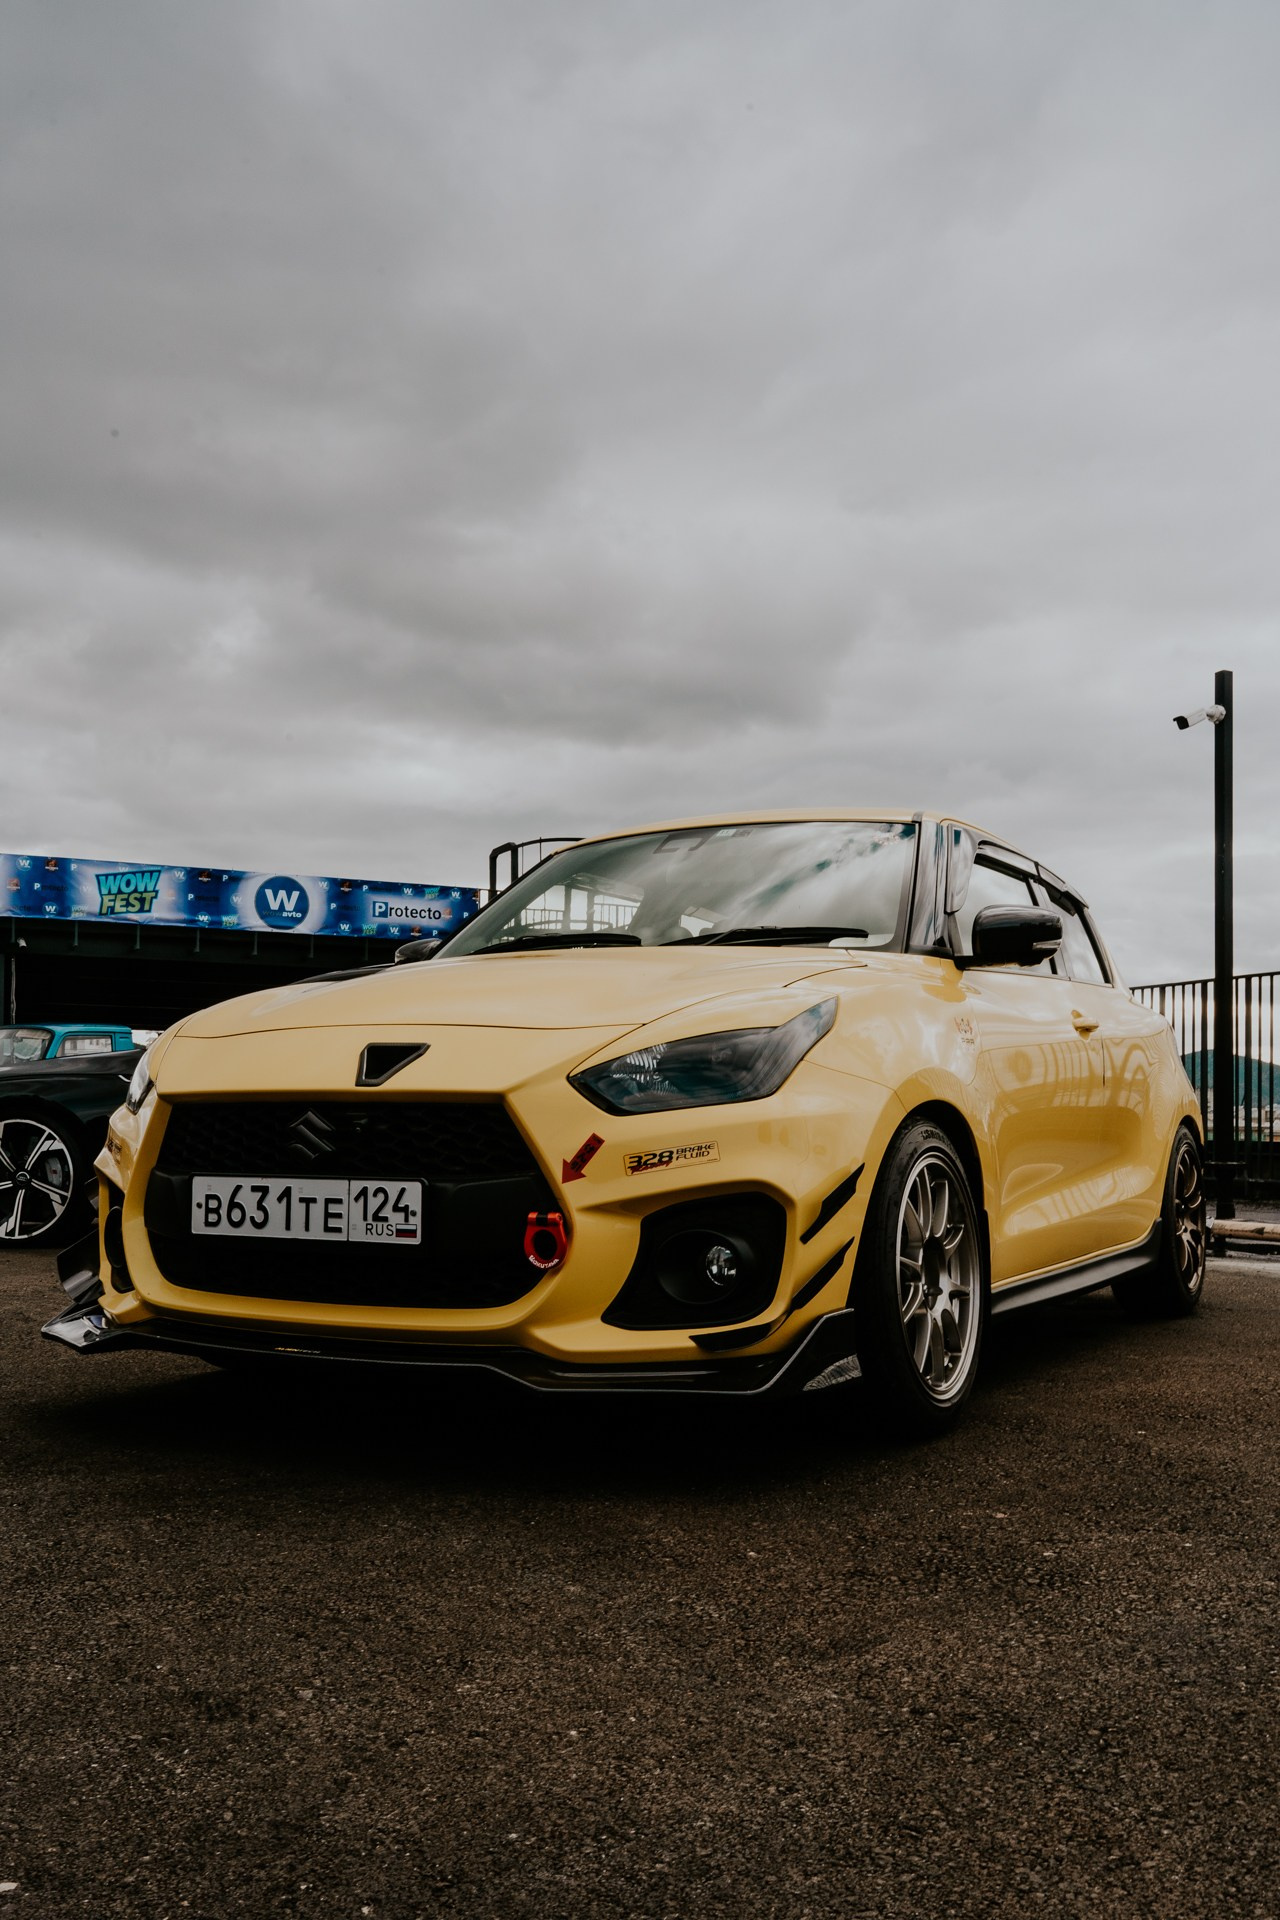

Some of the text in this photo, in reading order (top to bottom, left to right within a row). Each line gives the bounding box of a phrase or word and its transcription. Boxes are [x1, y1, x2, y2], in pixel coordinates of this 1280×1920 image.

[99, 872, 159, 895] WOW
[101, 891, 156, 914] FEST
[264, 888, 300, 911] W
[374, 902, 442, 920] Protecto
[675, 1150, 710, 1161] FLUID
[676, 1143, 716, 1155] BRAKE
[627, 1150, 674, 1169] 328
[353, 1186, 410, 1223] 124
[365, 1222, 394, 1237] RUS
